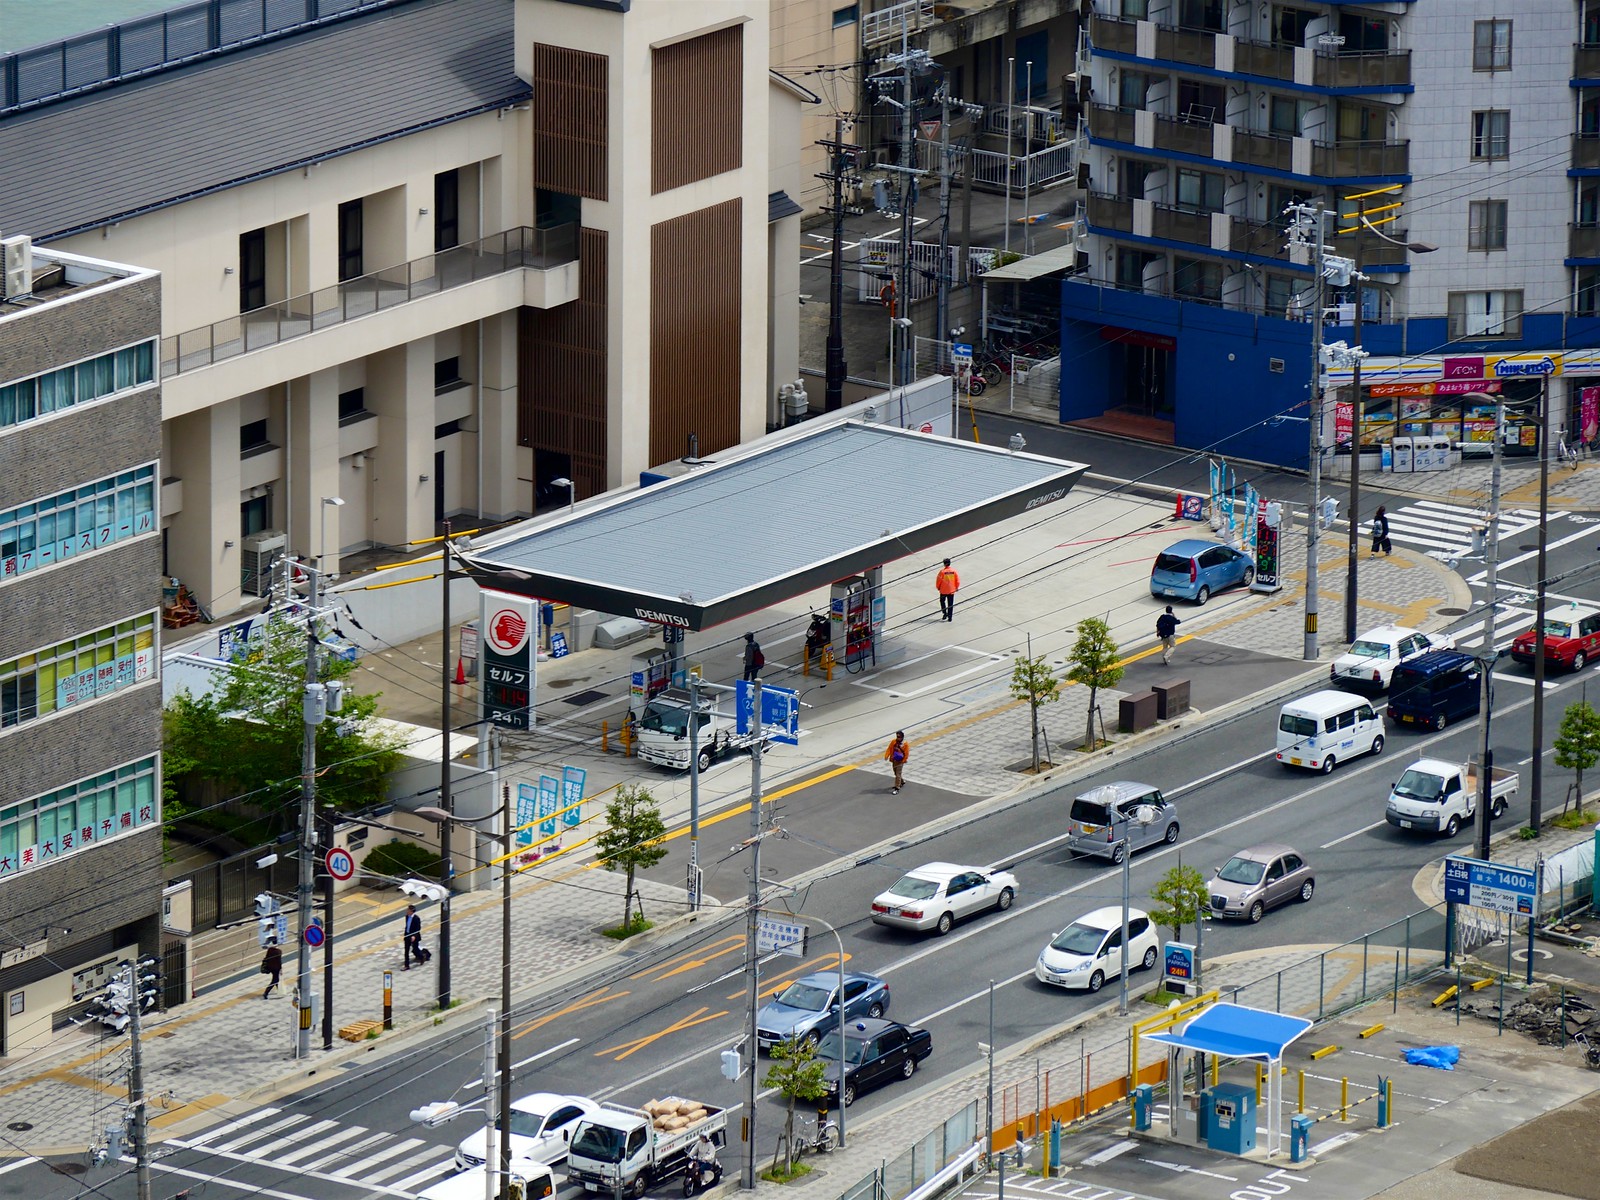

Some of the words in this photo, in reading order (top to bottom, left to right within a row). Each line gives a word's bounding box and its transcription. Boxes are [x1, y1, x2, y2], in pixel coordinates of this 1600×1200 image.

[1025, 488, 1066, 510] IDEMITSU
[5, 514, 150, 575] 都アートスクール
[1257, 573, 1276, 582] セルフ
[634, 607, 690, 627] IDEMITSU
[489, 667, 525, 685] セルフ
[332, 856, 349, 873] 40
[1167, 958, 1190, 968] PARKING
[1172, 954, 1185, 962] FUJI
[1171, 967, 1186, 977] 24H
[1229, 1168, 1310, 1200] OUT
